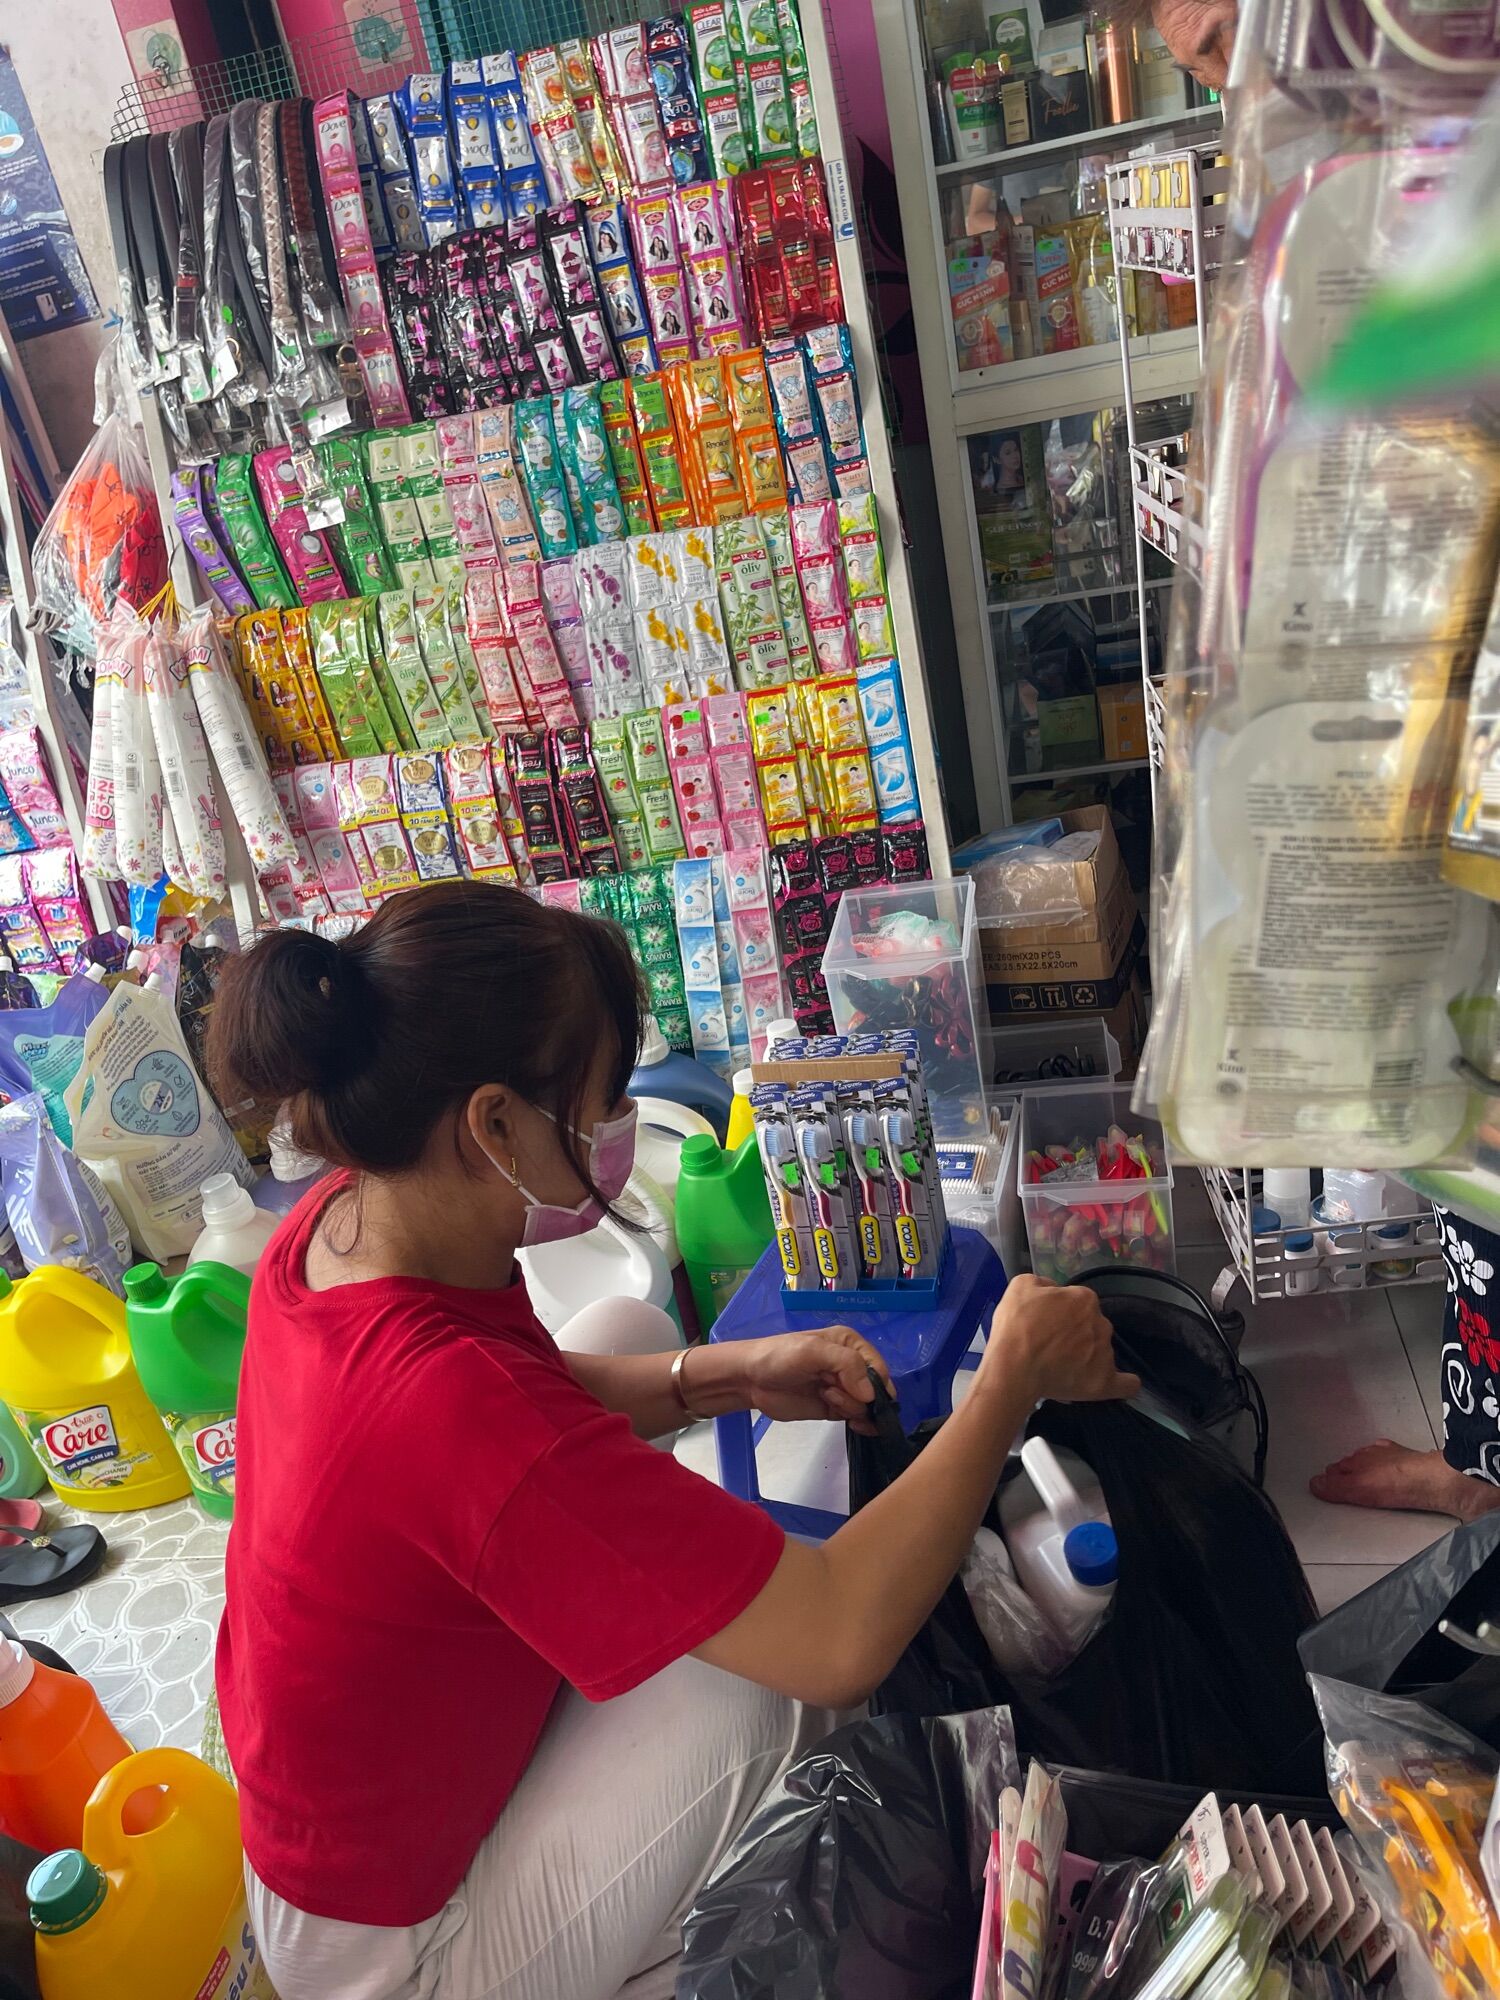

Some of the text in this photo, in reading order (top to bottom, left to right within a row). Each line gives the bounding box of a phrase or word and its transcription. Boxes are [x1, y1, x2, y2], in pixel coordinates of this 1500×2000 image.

[696, 18, 721, 30] CLEAR
[612, 30, 638, 42] CLEAR
[454, 63, 480, 74] Dove
[485, 60, 511, 73] Dove
[412, 75, 440, 83] Dove
[754, 78, 781, 89] CLEAR
[711, 112, 736, 125] CLEAR
[320, 120, 347, 133] Dove
[465, 144, 490, 154] Dove
[333, 198, 360, 212] Dove
[350, 276, 374, 290] Dove
[793, 350, 800, 358] 2
[367, 357, 392, 370] Dove
[694, 364, 718, 374] Rejoice
[842, 372, 850, 381] 2
[705, 439, 730, 449] Rejoice
[719, 512, 743, 522] Rejoice
[757, 550, 765, 558] 2
[774, 631, 780, 639] 2
[632, 719, 655, 728] Fresh
[600, 754, 622, 765] Fresh
[646, 794, 669, 802] Fresh
[618, 826, 641, 834] Fresh
[15, 947, 45, 959] Surf
[645, 951, 672, 962] RAMUS
[1041, 950, 1062, 960] PCS
[656, 997, 682, 1007] RAMUS
[46, 1423, 109, 1459] Care
[197, 1429, 236, 1465] Ca
